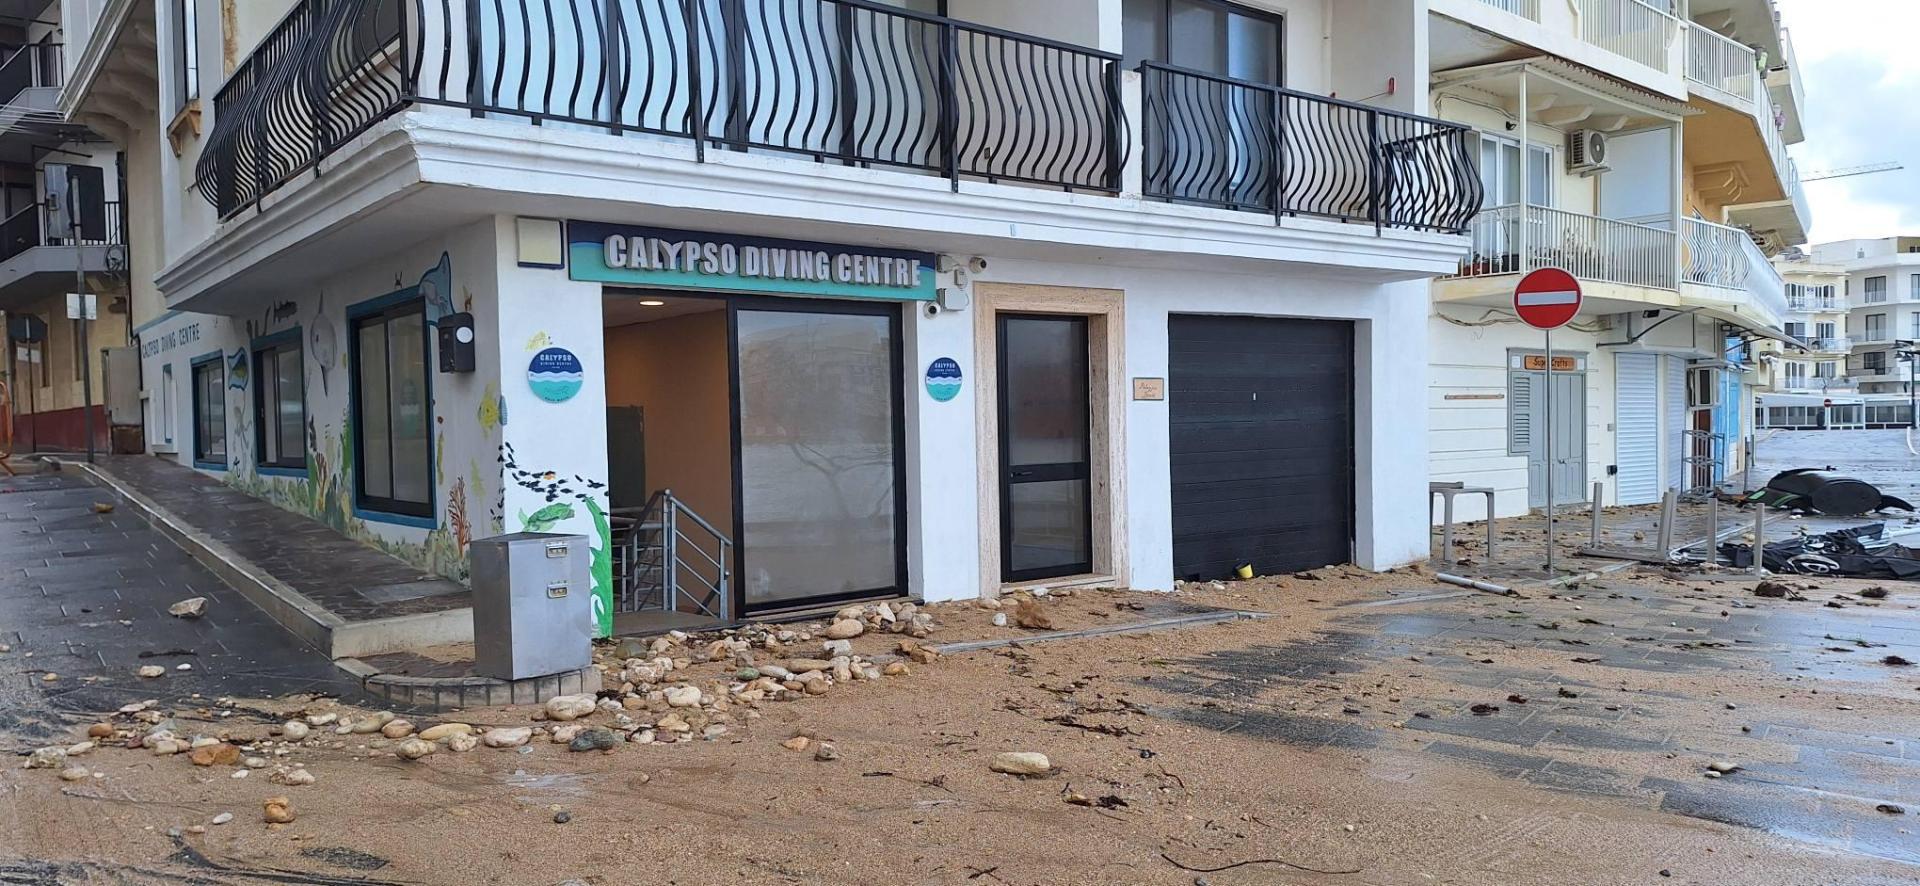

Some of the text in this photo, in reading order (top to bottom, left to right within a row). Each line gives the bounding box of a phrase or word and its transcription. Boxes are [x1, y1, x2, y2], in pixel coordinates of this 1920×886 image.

[604, 234, 922, 288] CALYPSO DIVING CENTRE
[142, 322, 200, 359] CALYPSO DIVING CENTRE
